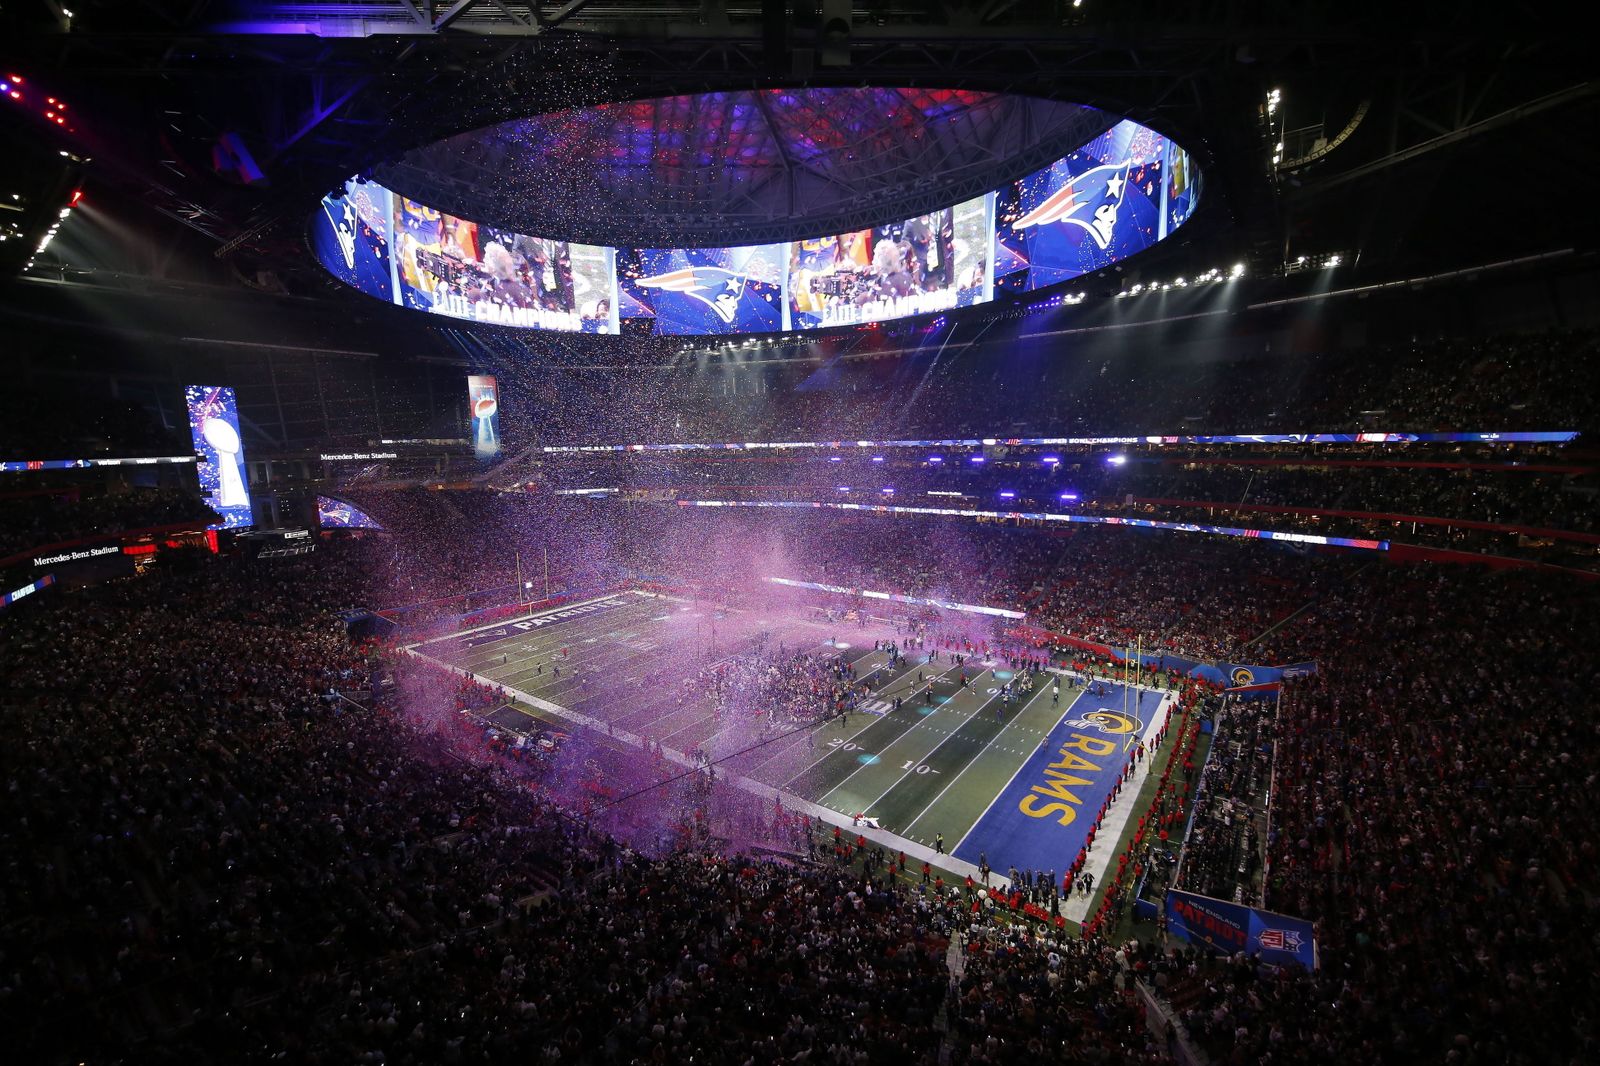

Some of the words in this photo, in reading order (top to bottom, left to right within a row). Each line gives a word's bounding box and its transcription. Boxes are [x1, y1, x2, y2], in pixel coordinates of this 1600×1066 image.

[475, 299, 582, 331] CHAMPIONS
[320, 453, 370, 461] Mercedes-Benz
[33, 552, 90, 566] Mercedes-Benz
[90, 546, 119, 557] Stadium
[512, 601, 626, 630] PATRIOTS
[827, 738, 858, 751] 20
[901, 760, 932, 774] 10
[1019, 733, 1117, 827] RAMS
[1188, 900, 1205, 912] NEW
[1205, 908, 1241, 930] ENGLAND
